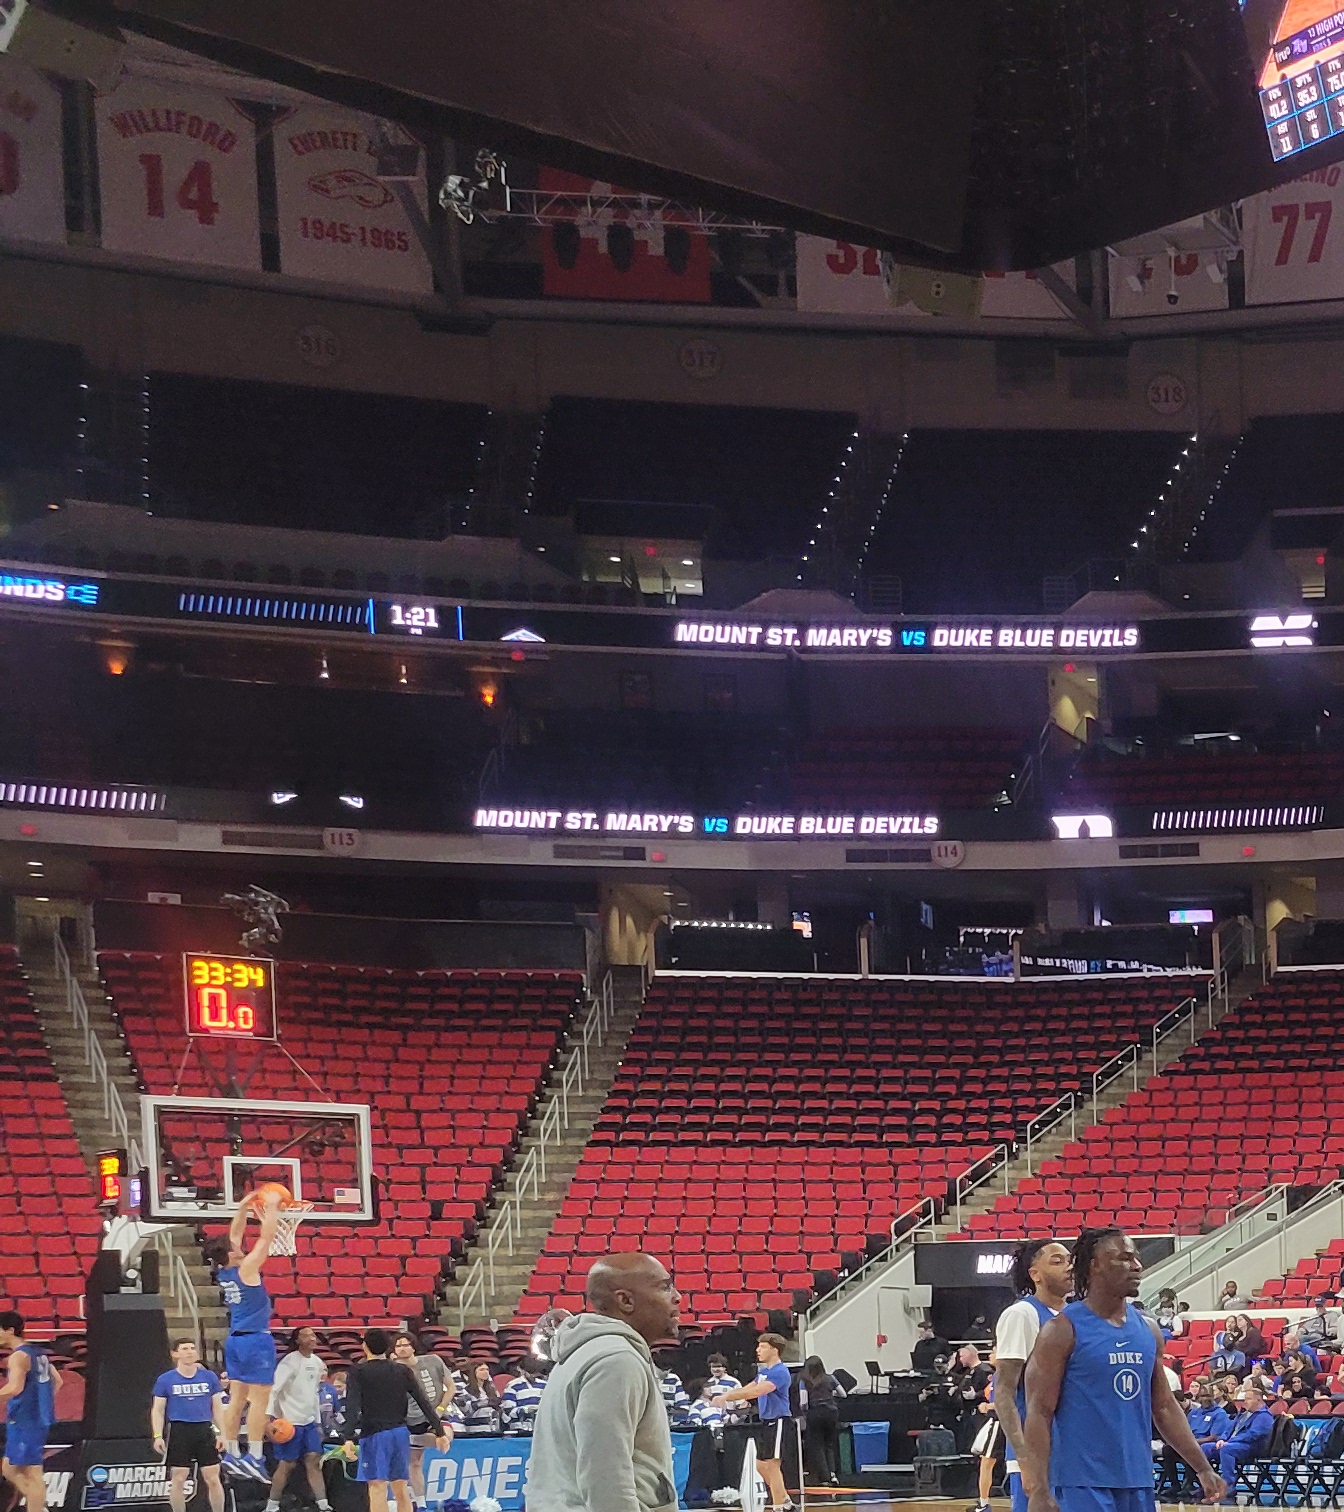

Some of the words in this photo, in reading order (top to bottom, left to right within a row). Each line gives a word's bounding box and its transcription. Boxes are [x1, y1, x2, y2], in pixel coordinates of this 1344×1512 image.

[1316, 18, 1334, 36] HIGH
[109, 108, 238, 155] WILLIFORD
[288, 132, 358, 156] EVERETT
[139, 153, 220, 226] 14
[302, 216, 409, 252] 1945-1965
[1271, 201, 1332, 266] 77
[1151, 385, 1183, 404] 318
[391, 605, 439, 628] 1:21
[676, 624, 763, 645] MOUNT
[766, 626, 800, 646] ST.
[806, 628, 892, 647] MARY'S
[902, 630, 926, 646] VS
[932, 629, 991, 647] DUKE
[997, 628, 1053, 647] BLUE
[1059, 628, 1138, 647] DEVILS
[474, 809, 560, 829] MOUNT
[564, 811, 599, 830] ST.
[605, 812, 694, 833] MARY'S
[703, 816, 728, 833] VS
[735, 816, 794, 834] DUKE
[798, 816, 854, 834] BLUE
[858, 816, 939, 834] DEVILS
[329, 832, 355, 846] 113
[936, 844, 957, 858] 114
[192, 961, 264, 988] 33:34
[201, 987, 254, 1030] 0.0
[1109, 1352, 1143, 1364] DUKE
[172, 1382, 209, 1395] DUKE
[1122, 1376, 1133, 1392] 14
[108, 1466, 167, 1483] MARCH
[116, 1479, 194, 1499] MADNES
